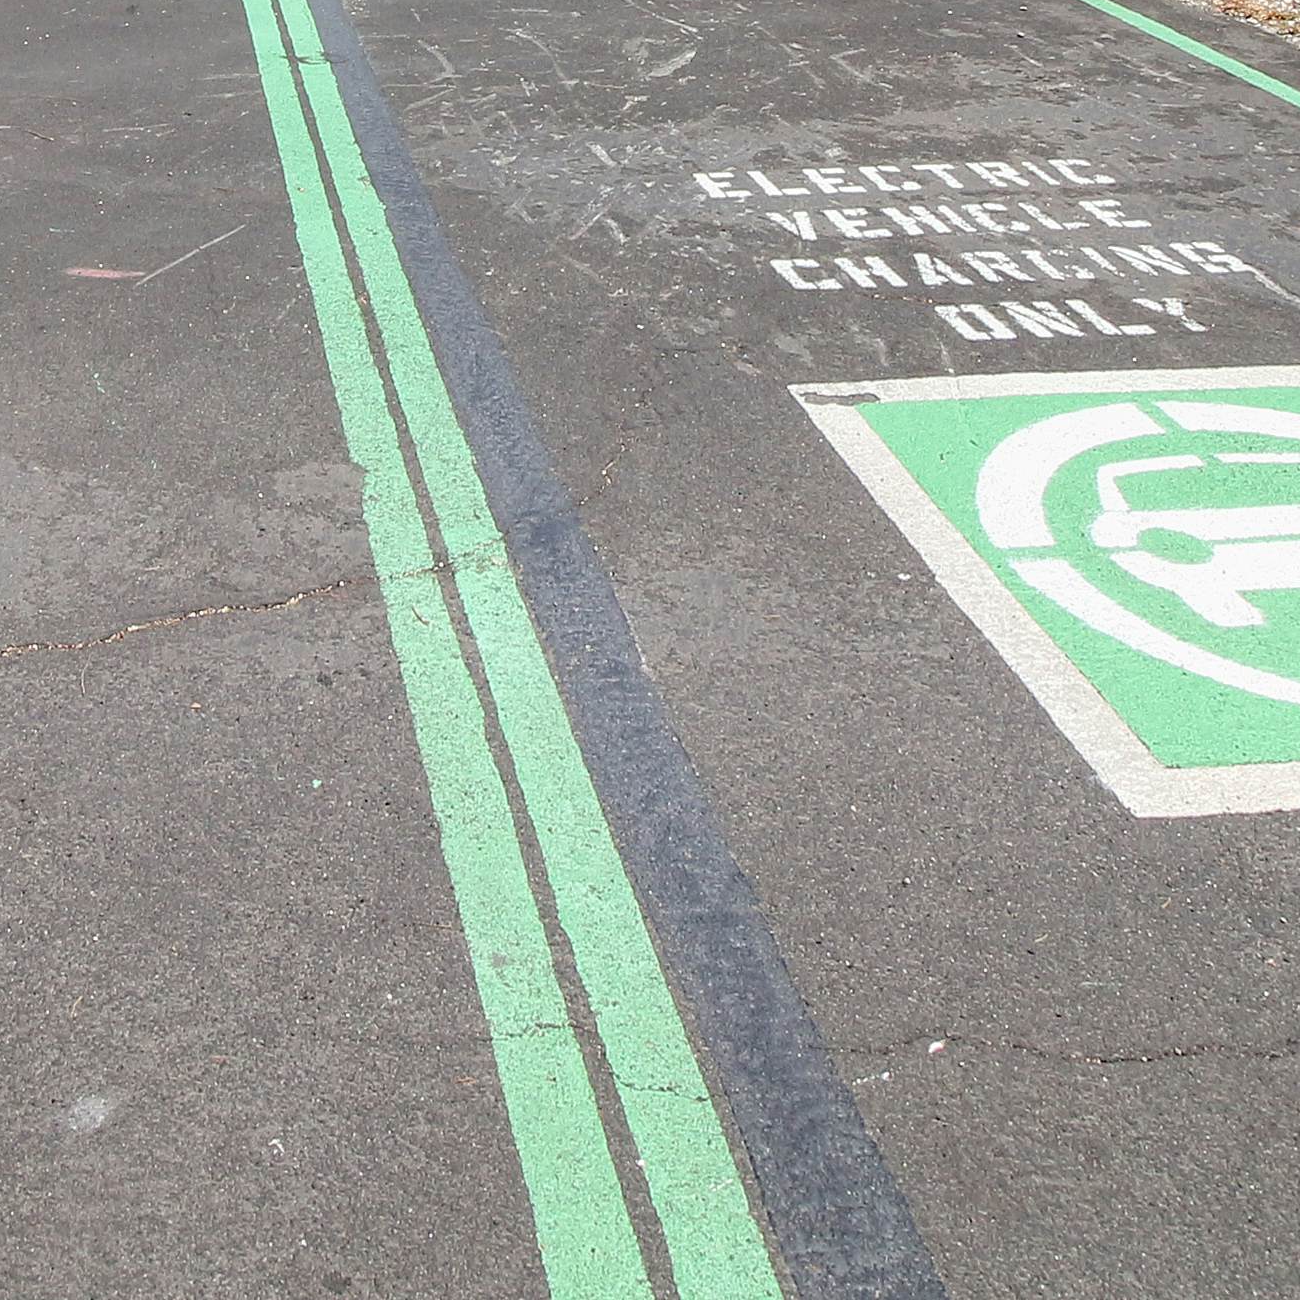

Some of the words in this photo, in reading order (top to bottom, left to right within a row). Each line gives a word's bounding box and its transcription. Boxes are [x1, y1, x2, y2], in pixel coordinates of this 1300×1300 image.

[693, 158, 1117, 199] ELECTRIC
[766, 198, 1153, 241] VEHICLE
[769, 241, 1248, 290] CHARGING
[934, 297, 1207, 341] ONLY
